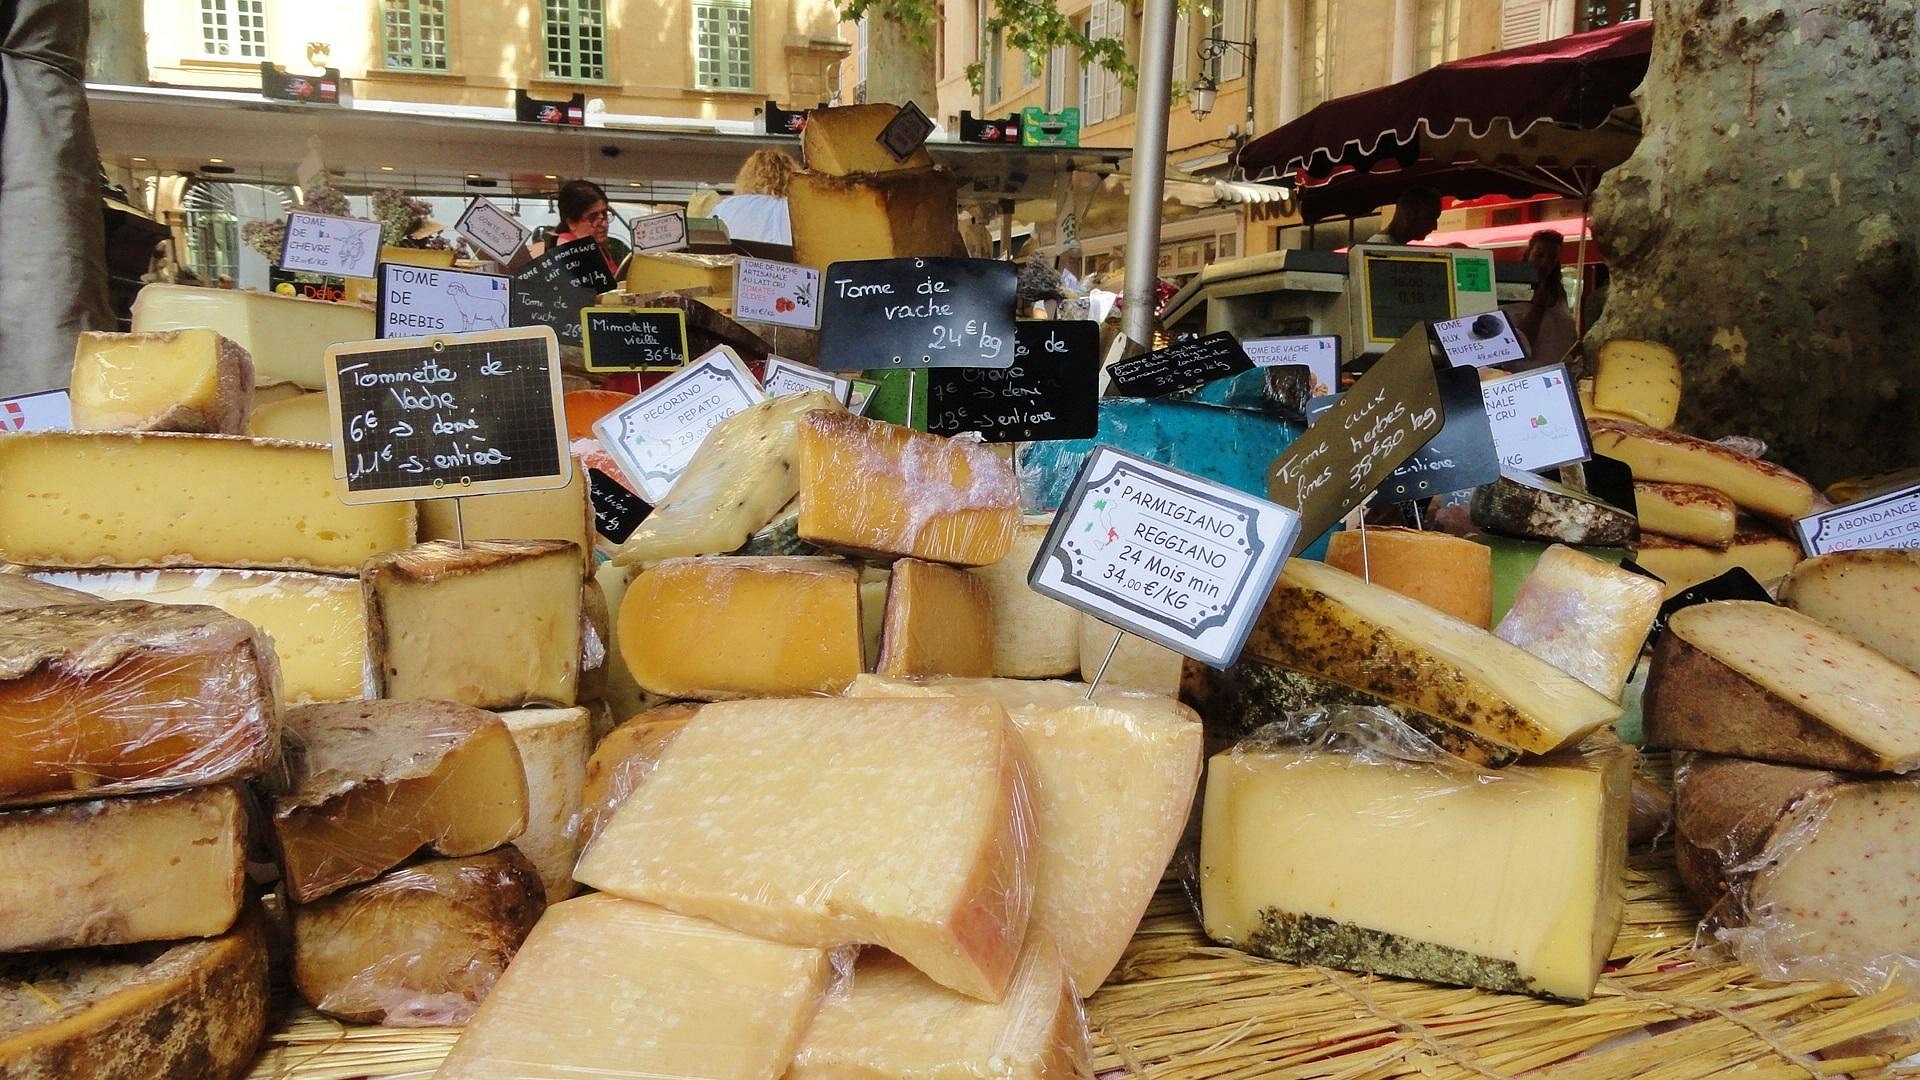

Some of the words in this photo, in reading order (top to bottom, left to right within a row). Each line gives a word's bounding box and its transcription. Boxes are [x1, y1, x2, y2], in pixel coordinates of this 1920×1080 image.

[295, 215, 326, 227] TOME
[292, 228, 307, 238] DE
[289, 241, 331, 254] CHEVRE
[518, 267, 538, 280] TOME
[542, 259, 552, 268] DE
[554, 243, 596, 260] MONTAGNE
[744, 260, 764, 270] TOME
[766, 264, 774, 272] DE
[392, 268, 439, 286] TOME
[544, 268, 560, 282] LAIT
[744, 269, 788, 281] ARTISANALE
[834, 278, 895, 299] Tome
[916, 276, 950, 294] de
[391, 290, 412, 305] DE
[884, 298, 954, 320] vache
[390, 312, 444, 330] BREBIS
[592, 318, 659, 334] Mimolette
[1436, 320, 1462, 332] TOME
[1044, 330, 1068, 353] de
[1442, 334, 1460, 344] AUX
[1248, 346, 1268, 355] TOME
[1284, 344, 1309, 352] VACHE
[1446, 342, 1484, 356] TRUFFES
[480, 352, 512, 376] de
[1251, 354, 1297, 362] RTISANALE
[1002, 380, 1042, 397] demi
[1492, 380, 1529, 396] VACHE
[643, 384, 702, 422] PECORINO
[678, 395, 721, 424] PEPATO
[1486, 396, 1516, 411] NALE
[1410, 407, 1437, 431] kg
[1496, 410, 1516, 422] CRU
[1350, 401, 1406, 453] herbes
[1276, 440, 1329, 484] Tome
[1120, 485, 1236, 538] PARMIGIANO
[1838, 502, 1918, 532] ABONDANCE
[1134, 522, 1226, 568] REGGIANO
[1827, 540, 1854, 552] AOC
[1856, 535, 1872, 546] AU
[1874, 526, 1903, 540] LAIT
[1906, 522, 1920, 531] CR
[1118, 545, 1141, 564] 24
[1144, 556, 1186, 582] Mois
[1188, 577, 1219, 598] min
